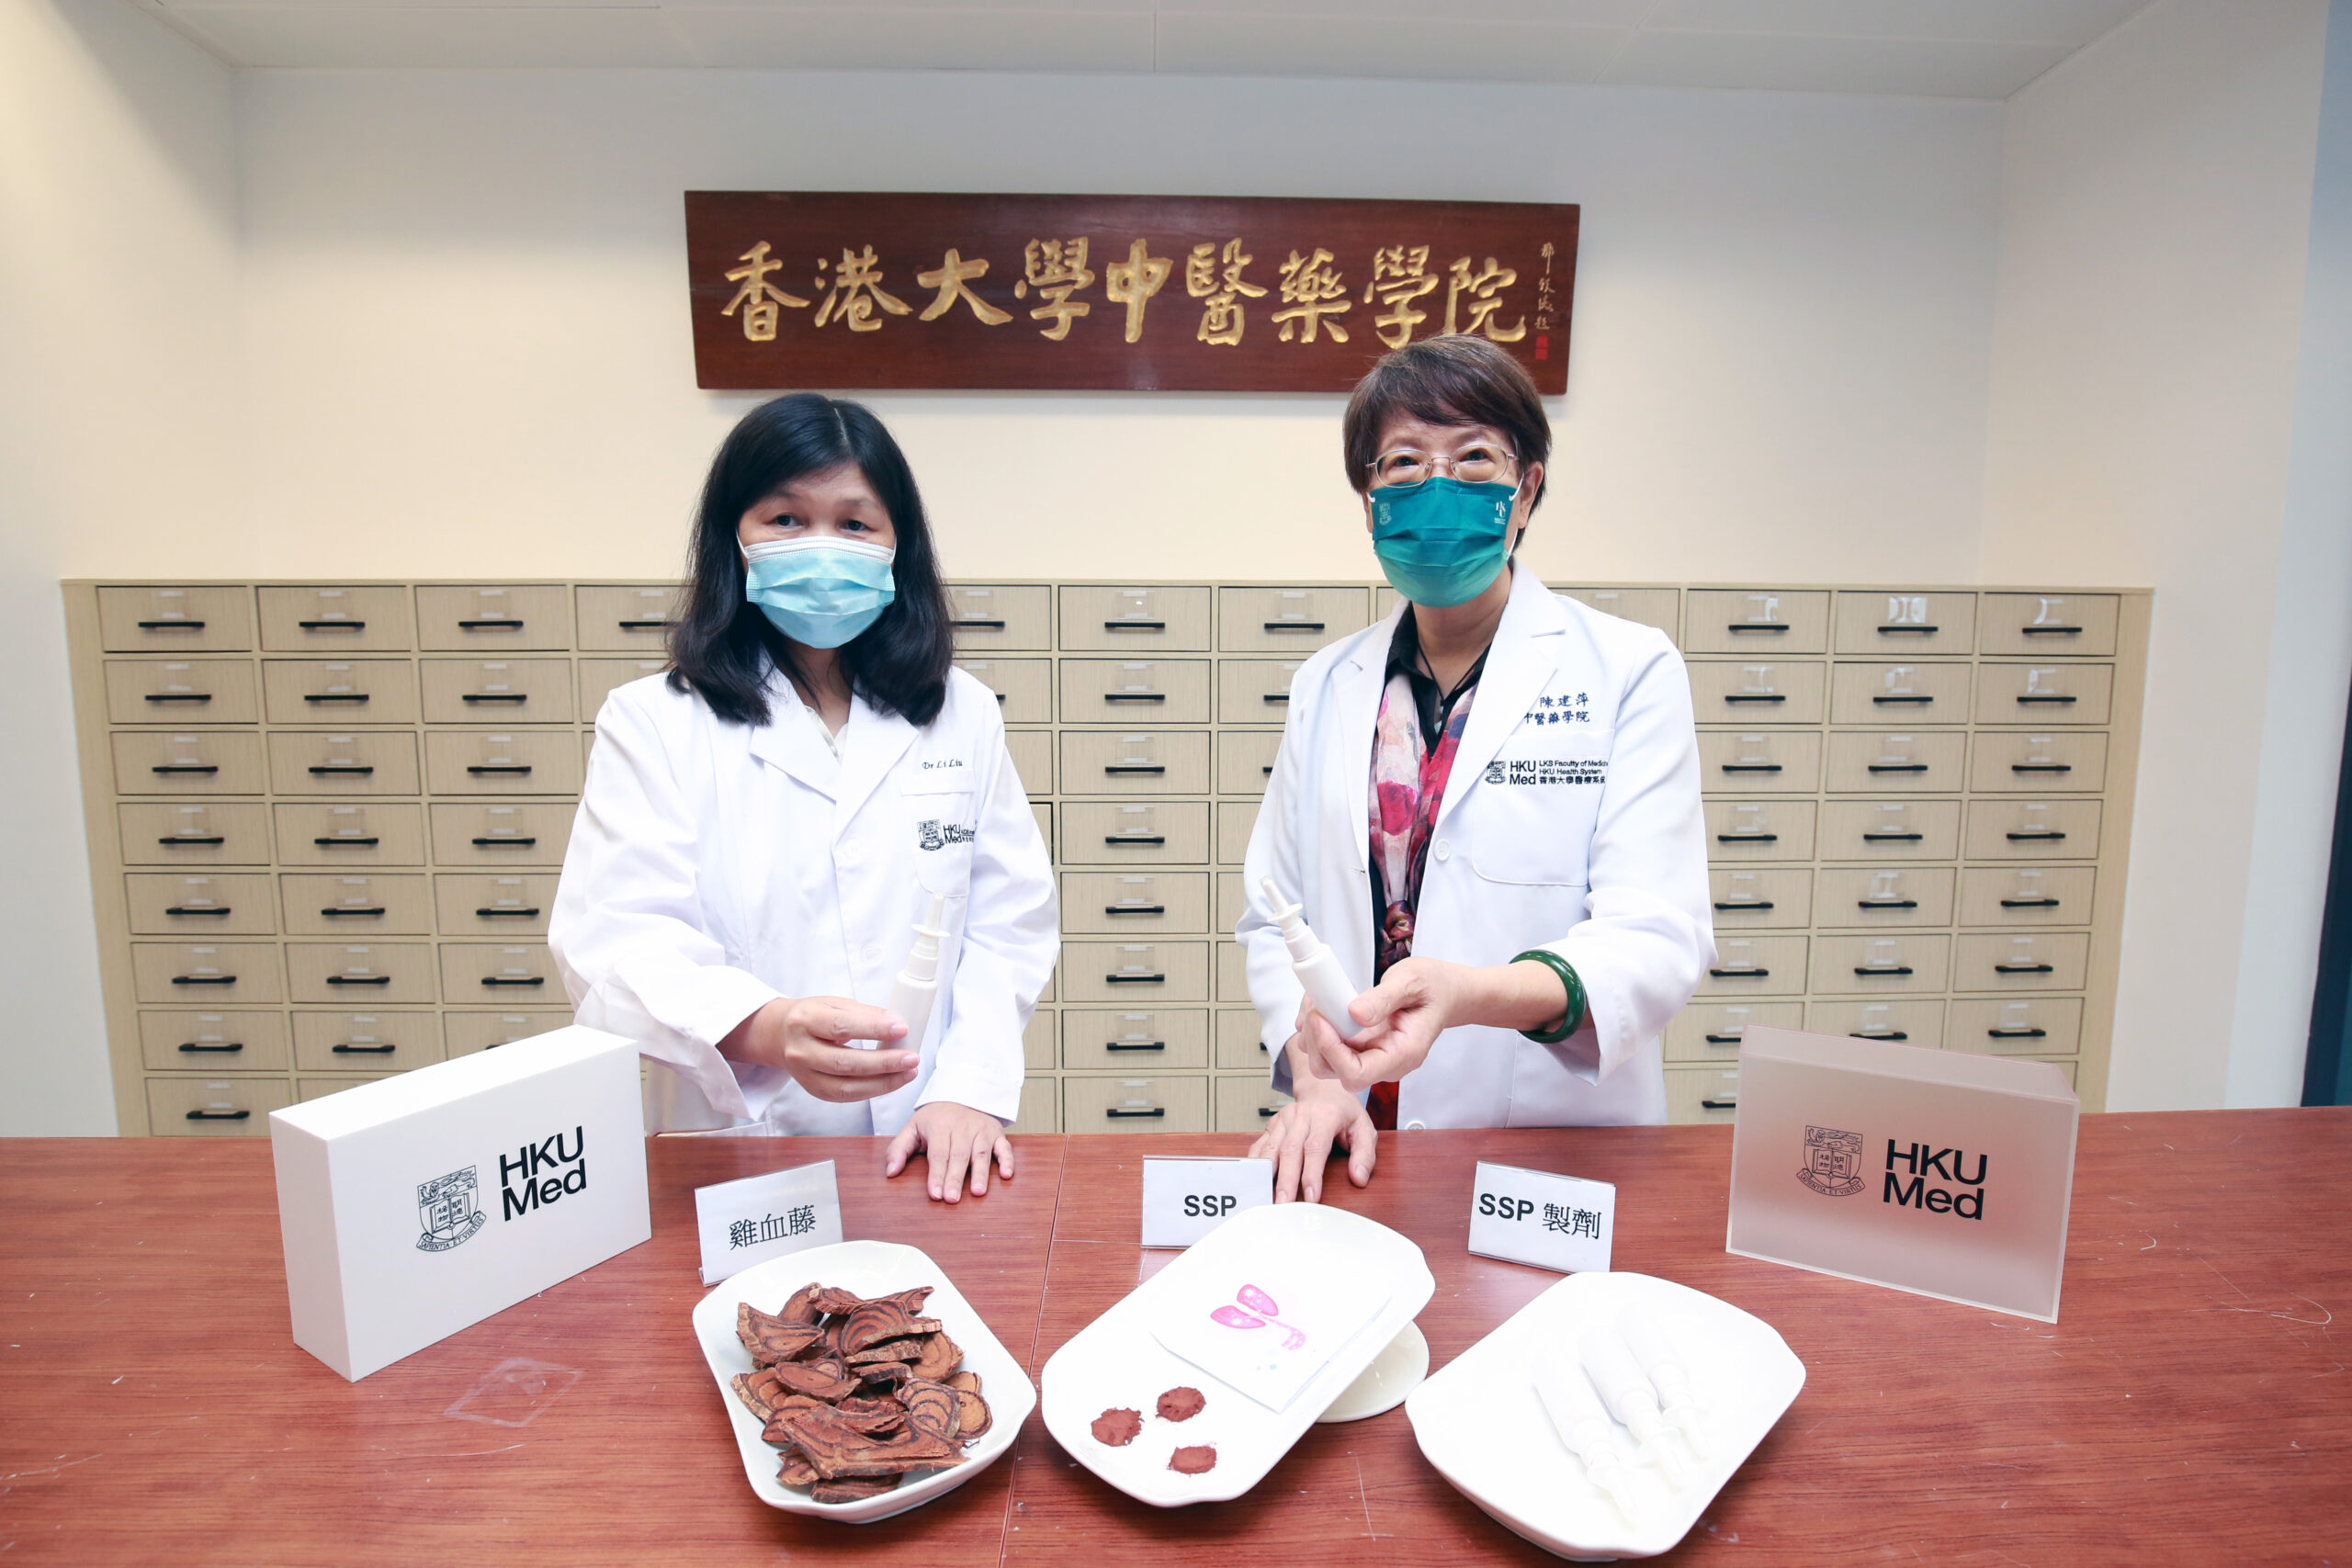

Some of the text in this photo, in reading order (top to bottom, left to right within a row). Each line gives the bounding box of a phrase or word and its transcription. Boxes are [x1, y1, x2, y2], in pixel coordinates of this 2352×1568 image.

[721, 236, 1527, 350] 香港大學中醫藥學院
[1540, 692, 1589, 708] 陳建萍
[1510, 760, 1536, 772] HKU
[1510, 773, 1536, 785] Med
[943, 823, 961, 834] HKU
[944, 830, 963, 844] Med
[500, 1125, 585, 1189] HKU
[1886, 1138, 1988, 1186] HKU
[503, 1157, 588, 1222] Med
[1183, 1194, 1238, 1217] SSP
[1883, 1171, 1984, 1221] Med
[729, 1204, 817, 1251] 雞血藤
[1478, 1192, 1602, 1240] SSP 製劑
